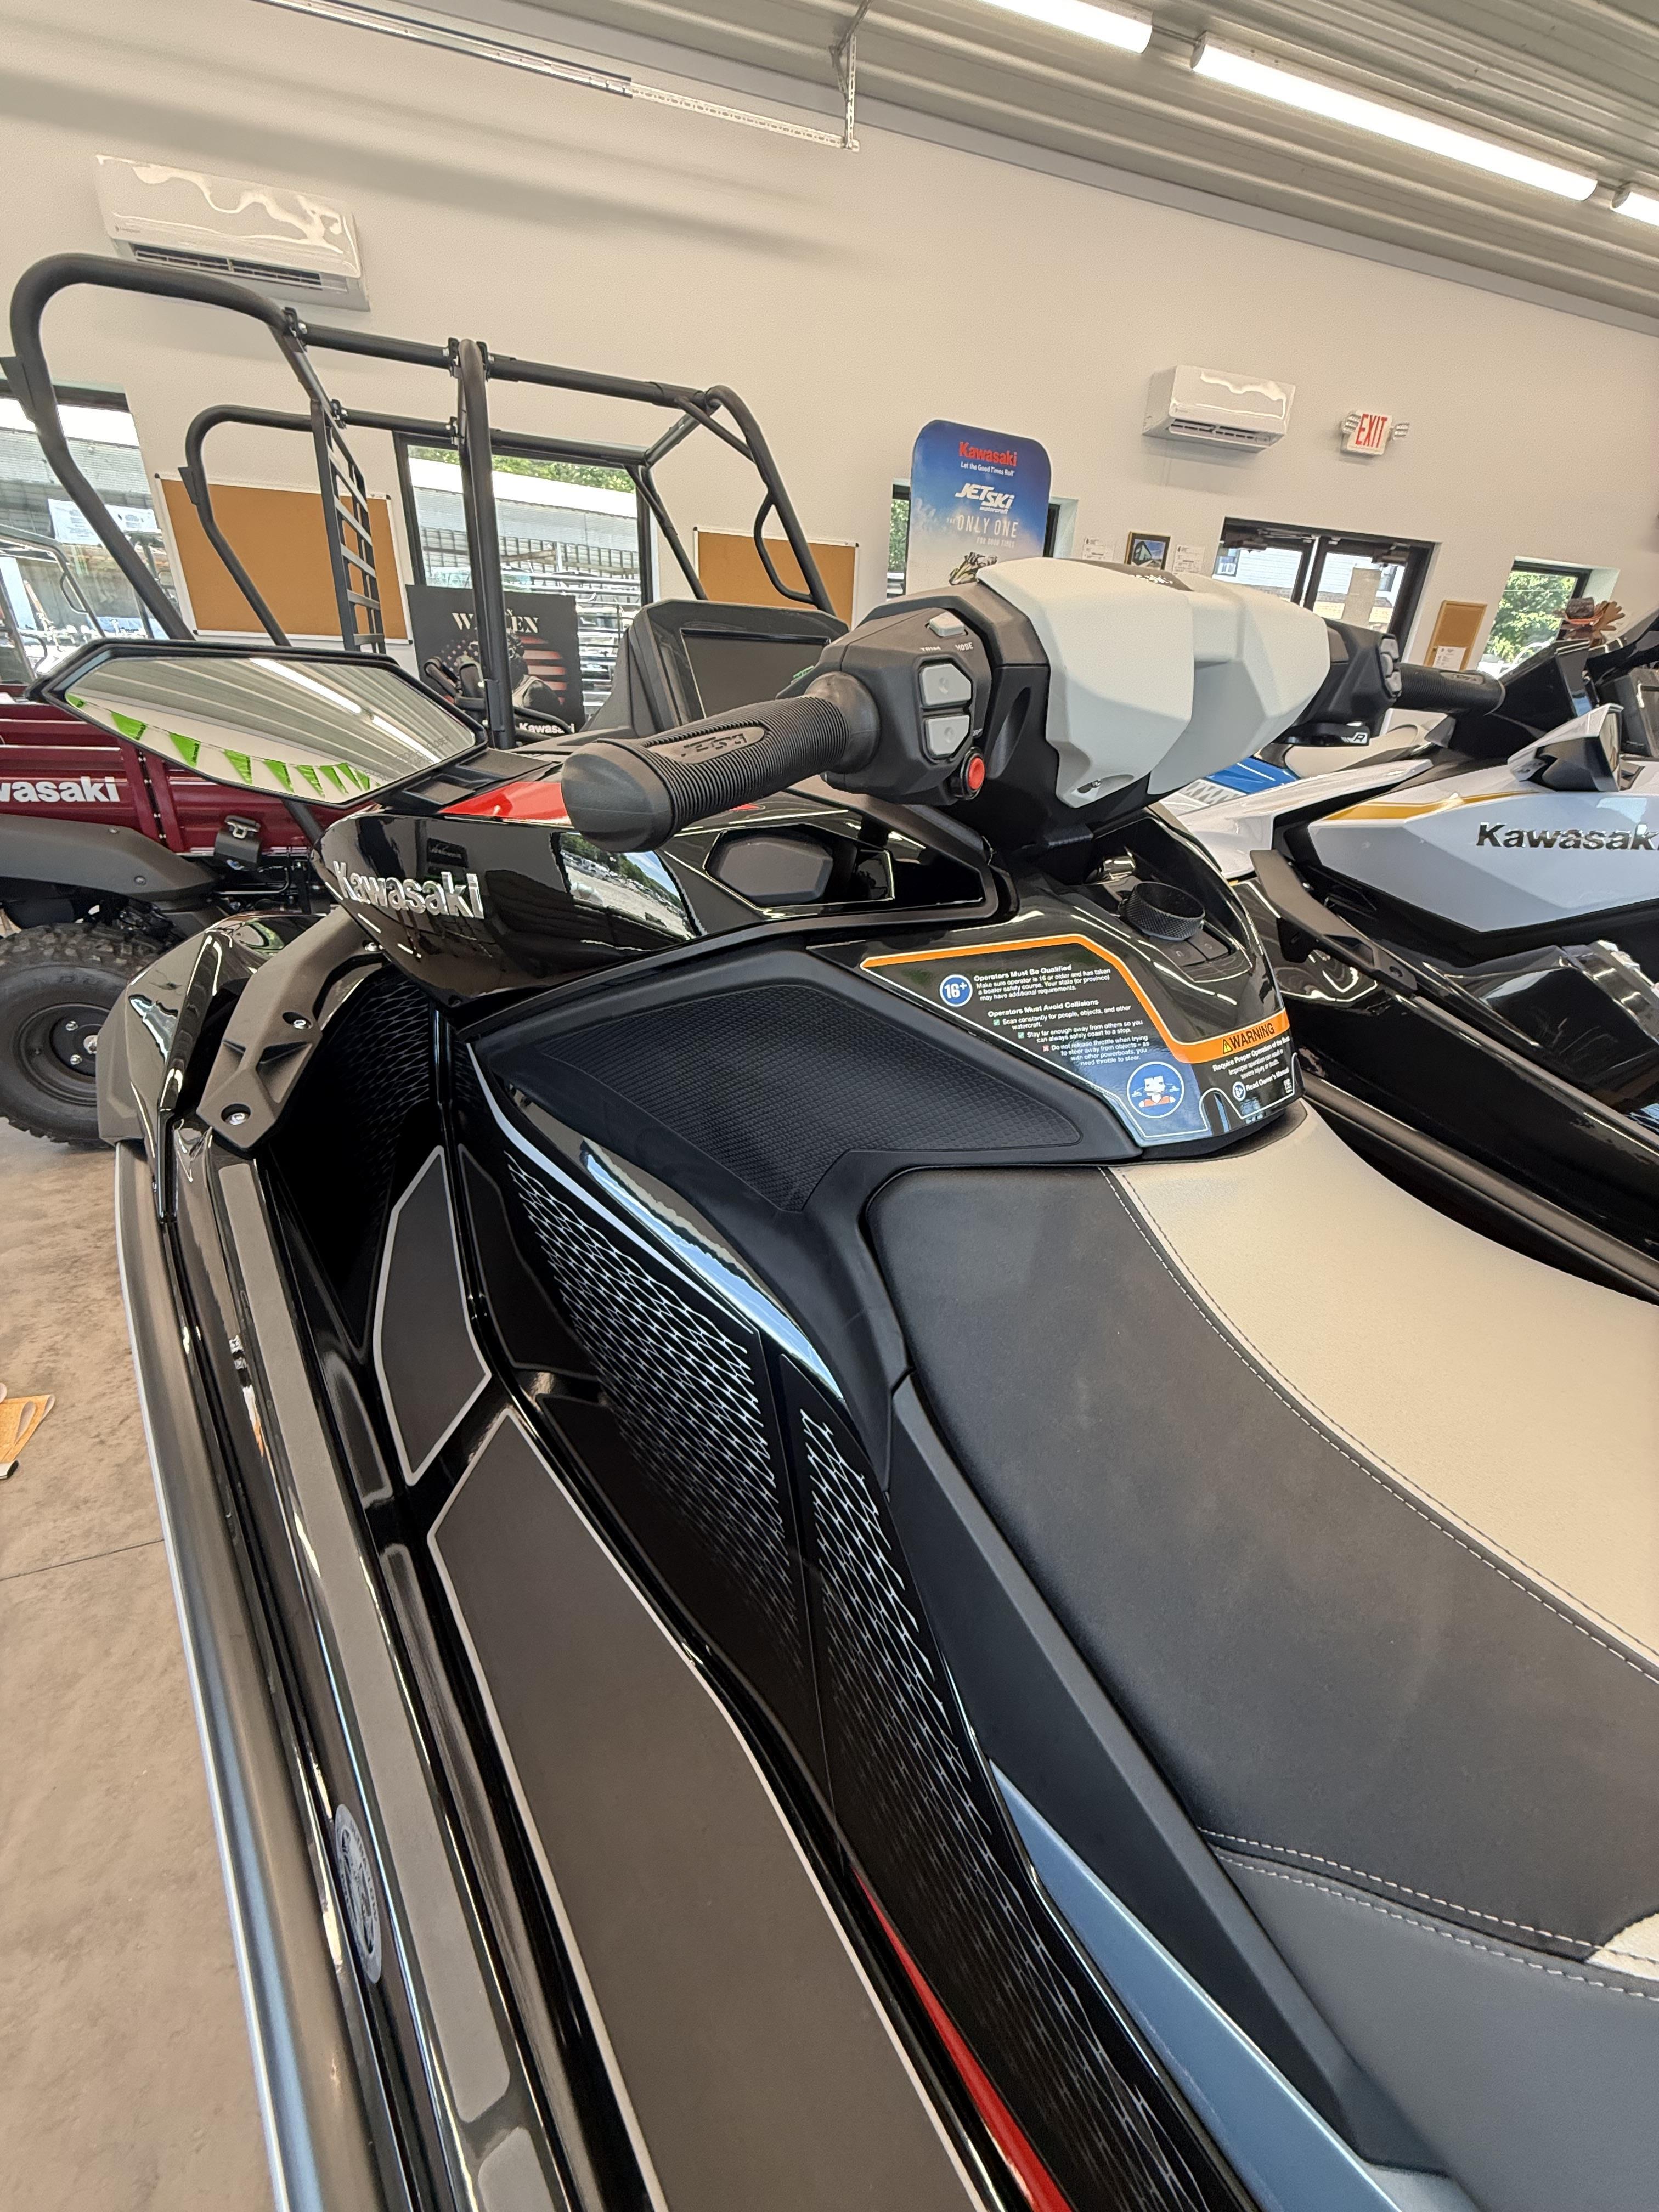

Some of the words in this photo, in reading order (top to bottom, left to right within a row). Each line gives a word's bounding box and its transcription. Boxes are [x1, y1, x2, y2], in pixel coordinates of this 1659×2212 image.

[1355, 413, 1387, 448] EXIT
[959, 442, 1017, 466] Kawasaki
[956, 514, 990, 534] ONLY
[994, 519, 1019, 538] ONE
[955, 642, 974, 651] MODE
[1476, 822, 1659, 850] Kawasak
[333, 861, 484, 919] Kawasaki
[974, 973, 1009, 982] Operators
[1041, 964, 1071, 974] Qualified
[1007, 978, 1031, 986] operator
[944, 982, 968, 999] 16+
[1003, 984, 1021, 993] safety
[1074, 977, 1082, 985] (or
[1084, 975, 1110, 984] province)
[1038, 986, 1076, 996] requirements.
[988, 1009, 1023, 1018] Operators
[1043, 1003, 1063, 1011] Avoid
[1064, 1000, 1099, 1009] Collisions
[1018, 1015, 1047, 1024] constantly
[1058, 1011, 1079, 1020] people,
[1081, 1009, 1103, 1017] objects,
[1048, 1034, 1069, 1042] always
[1069, 1032, 1087, 1040] safely
[1050, 1028, 1072, 1036] enough
[1229, 1022, 1275, 1049] WARNING
[1101, 1049, 1135, 1059] powerboats,
[1212, 1059, 1234, 1072] Require
[1234, 1053, 1251, 1063] Proper
[1246, 1081, 1259, 1092] Read
[1259, 1074, 1276, 1086] Owner's
